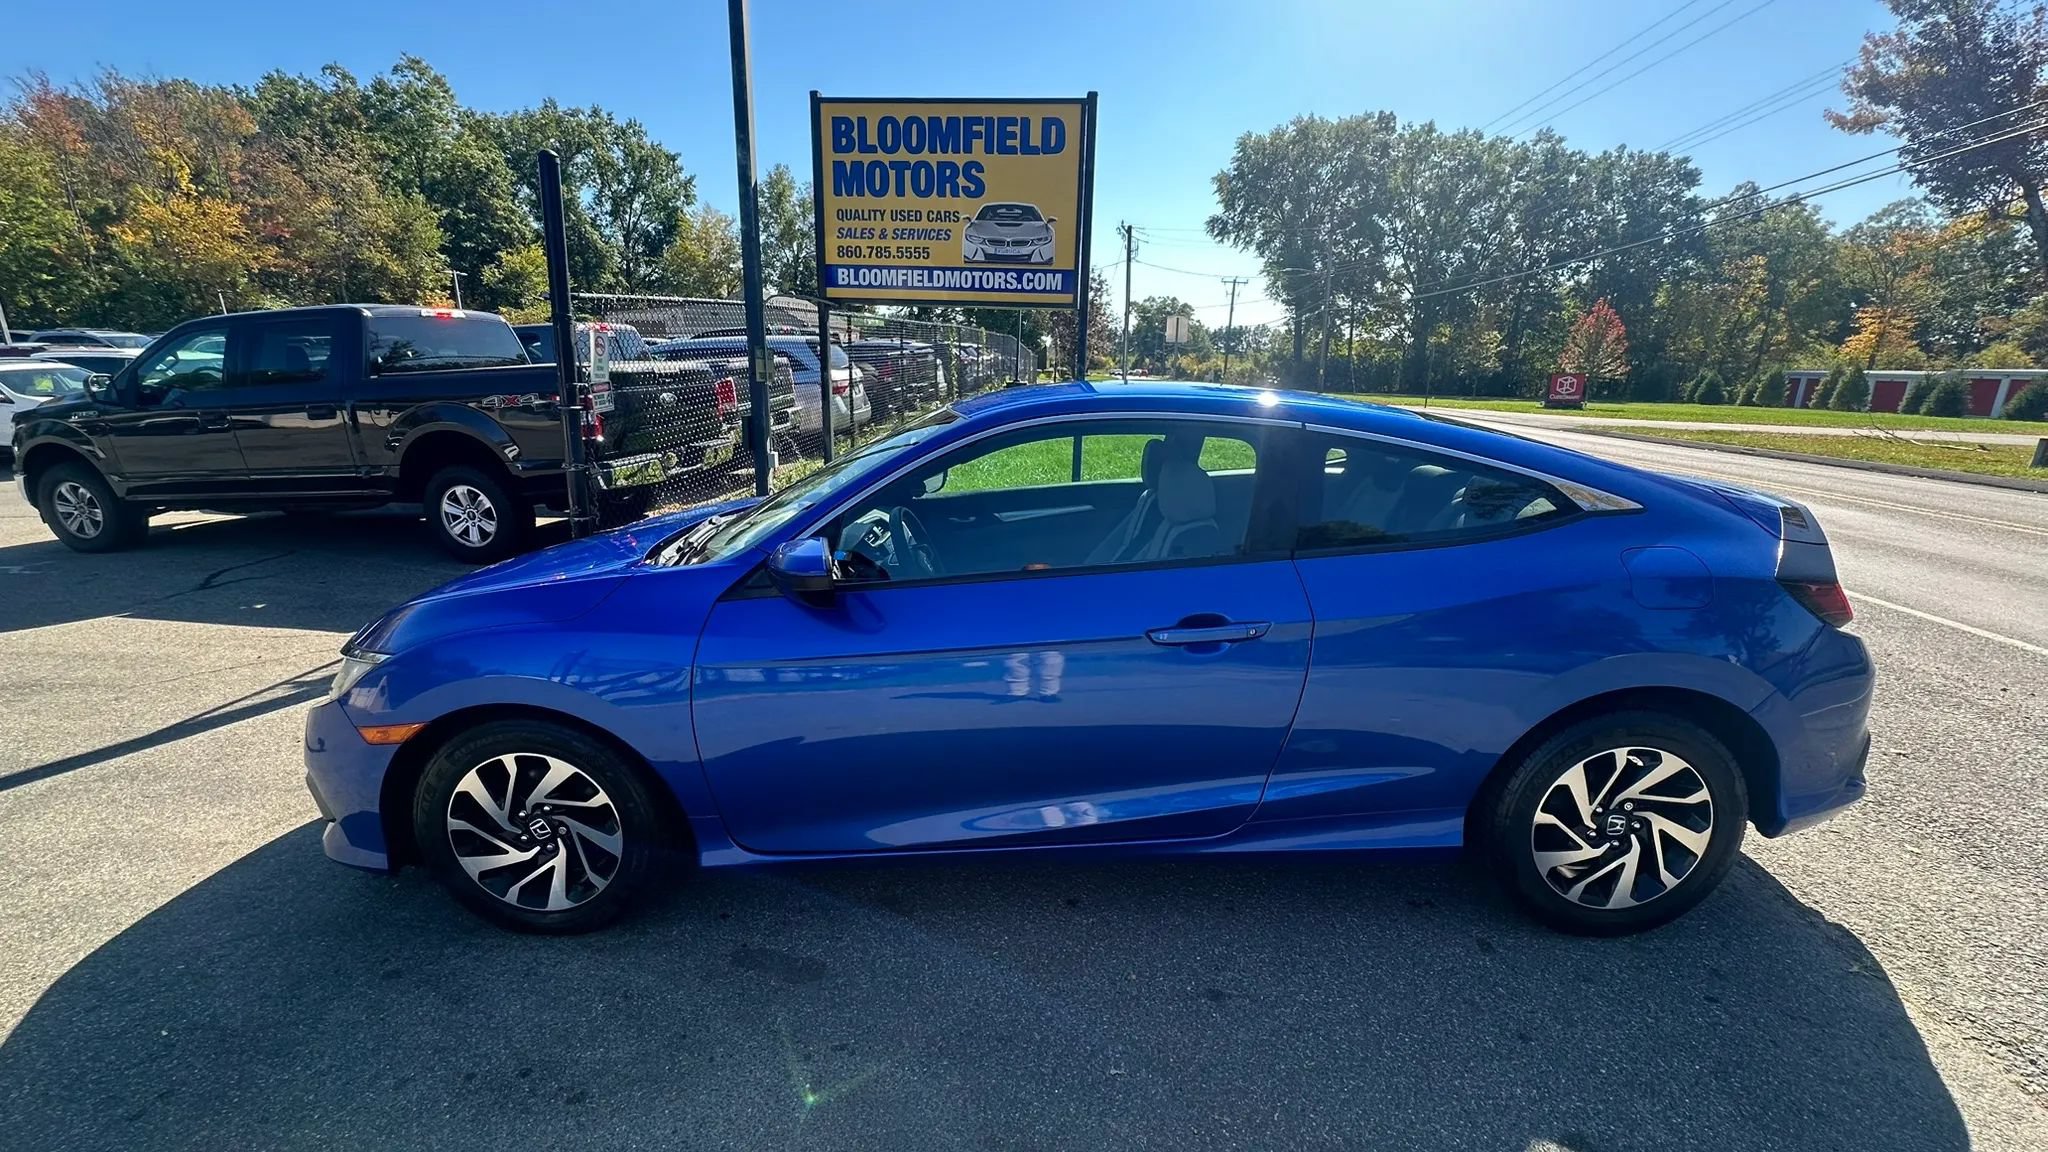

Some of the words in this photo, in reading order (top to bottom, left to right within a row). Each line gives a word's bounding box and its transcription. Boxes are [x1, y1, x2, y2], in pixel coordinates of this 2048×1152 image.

[832, 116, 1066, 155] BLOOMFIELD
[832, 160, 986, 198] MOTORS
[836, 209, 886, 223] QUALITY
[890, 210, 922, 223] USED
[927, 211, 961, 223] CARS
[836, 227, 875, 240] SALES
[878, 228, 888, 241] &
[892, 228, 951, 241] SERVICES
[837, 245, 930, 260] 860.785.5555
[838, 268, 1062, 291] BLOOMFIELDMOTORS.COM
